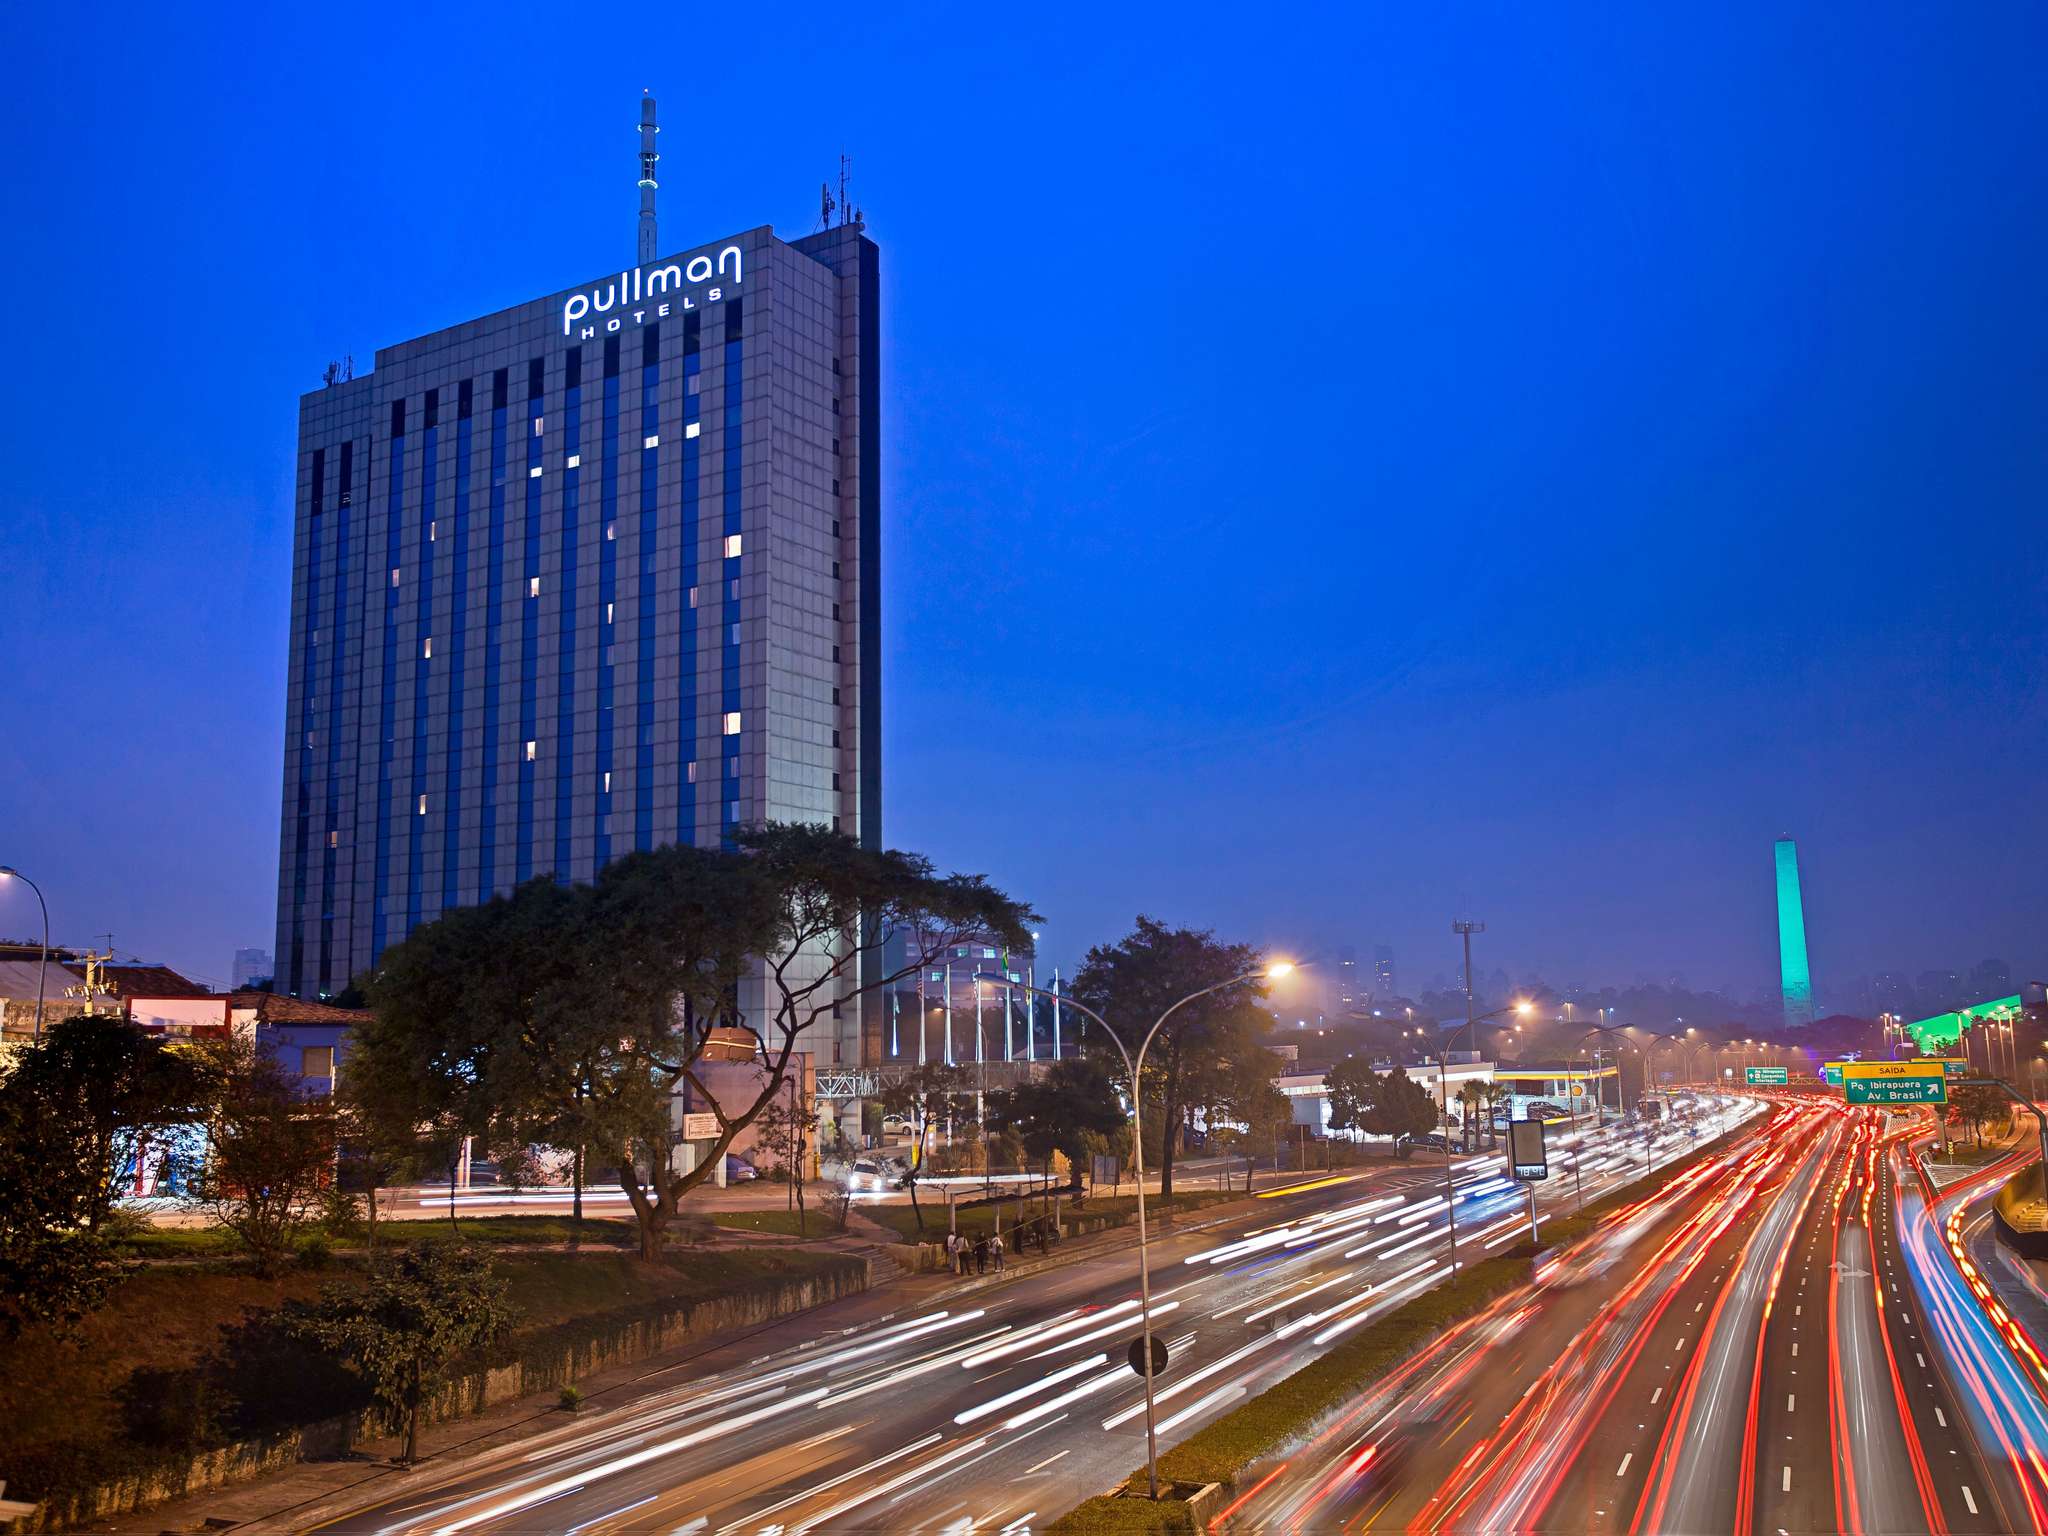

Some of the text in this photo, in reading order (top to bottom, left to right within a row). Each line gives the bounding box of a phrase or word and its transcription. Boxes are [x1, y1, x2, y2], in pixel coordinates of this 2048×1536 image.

[564, 246, 742, 336] pullman
[581, 288, 722, 340] HOTELS
[1851, 1081, 1921, 1091] Pq. Ibirapuera
[1868, 1091, 1922, 1100] Av. Brasil
